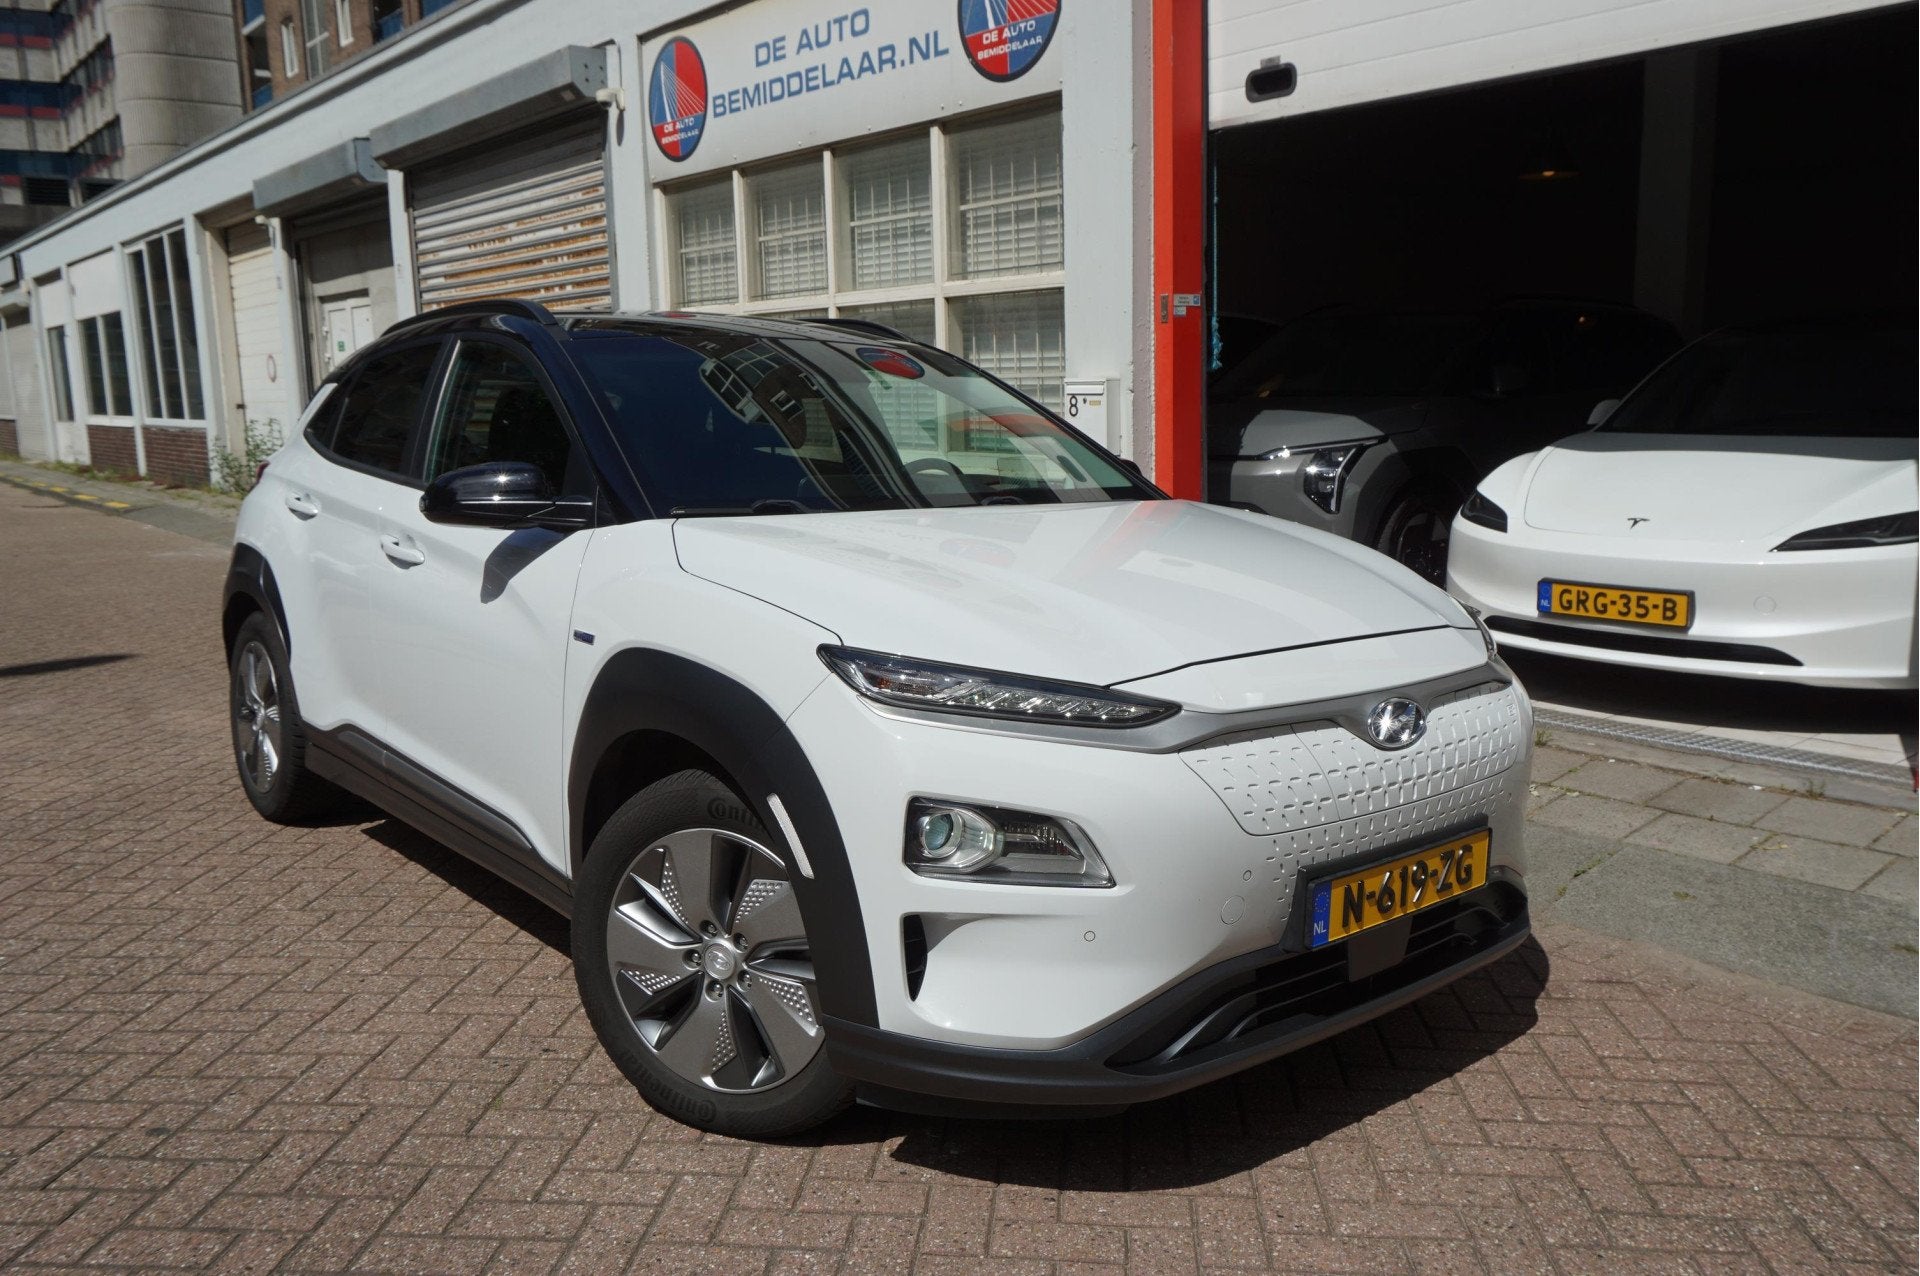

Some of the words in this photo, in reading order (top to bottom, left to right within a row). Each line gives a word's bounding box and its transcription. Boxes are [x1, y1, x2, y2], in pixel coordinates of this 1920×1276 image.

[755, 35, 786, 67] DE
[796, 8, 869, 55] AUTO
[982, 30, 998, 45] DE
[1002, 20, 1036, 39] AUTO
[977, 35, 1043, 60] BEMIDDELAAR
[712, 30, 949, 118] BEMIDDELAAR.NL
[664, 122, 674, 133] DE
[675, 117, 695, 130] AUTO
[1069, 395, 1078, 417] 8
[1540, 599, 1550, 607] NL
[1558, 588, 1678, 621] GRG-35-B
[1313, 919, 1327, 935] NL
[1342, 844, 1473, 928] N-619-ZG
